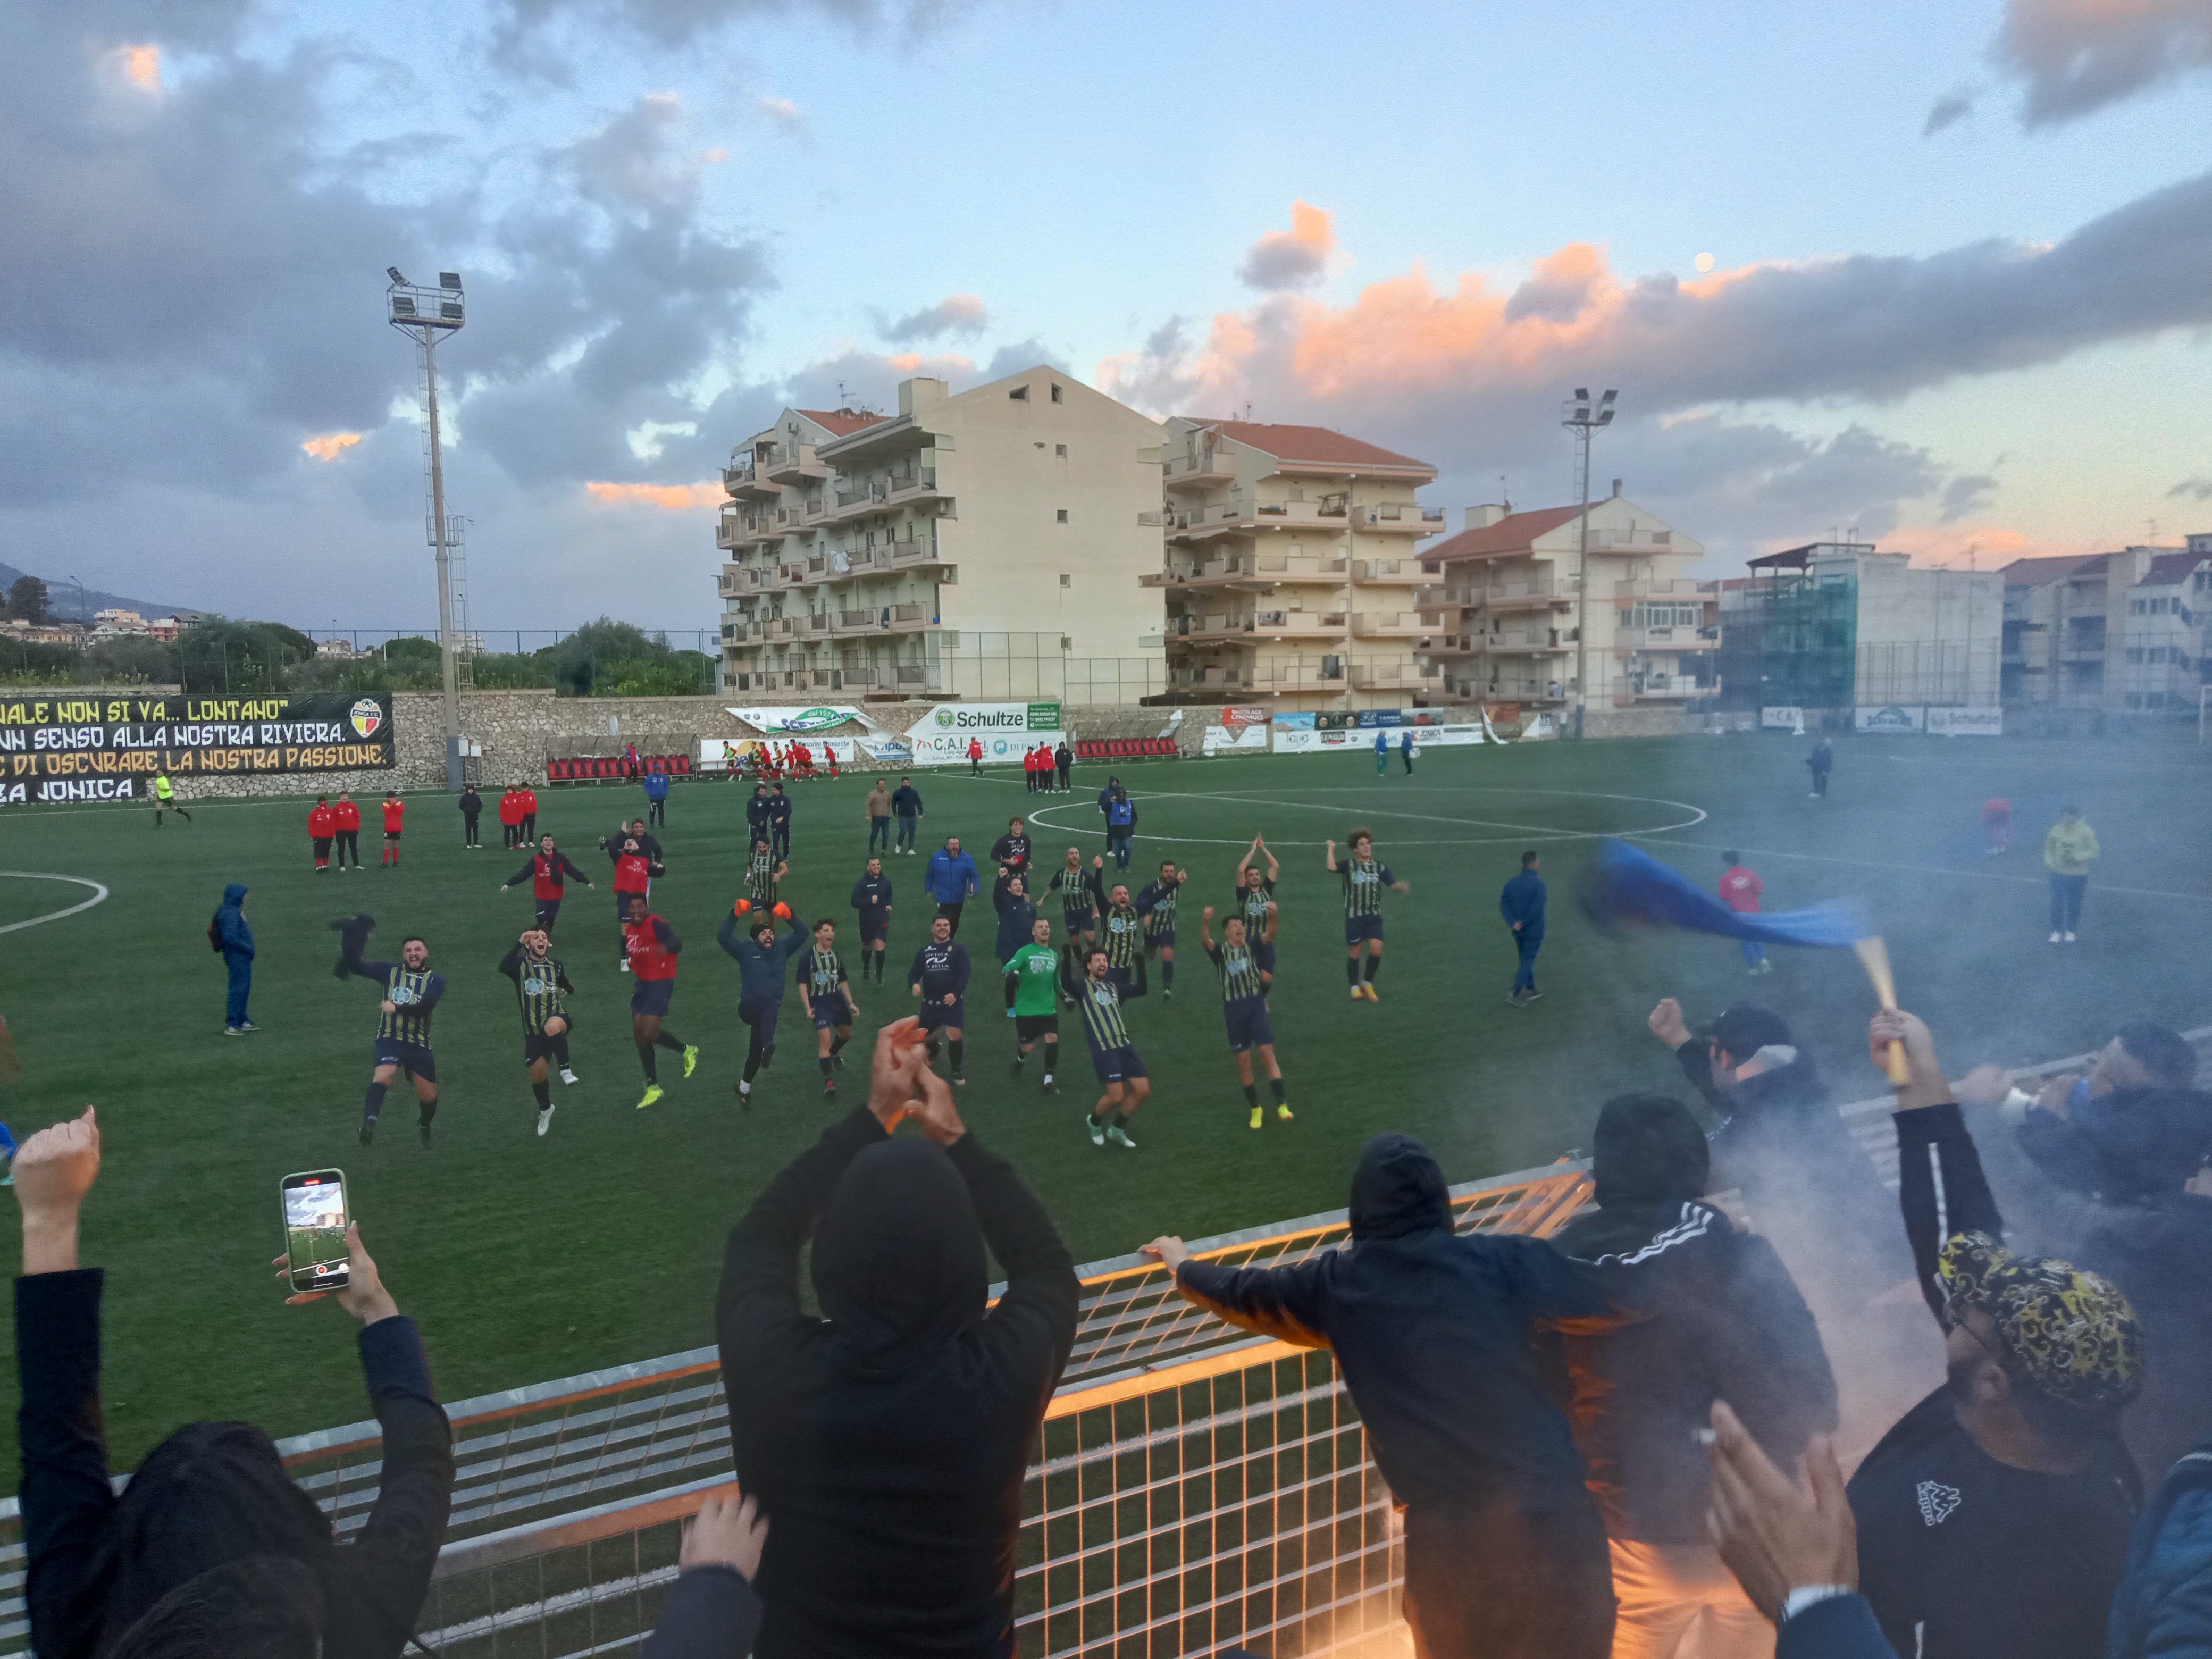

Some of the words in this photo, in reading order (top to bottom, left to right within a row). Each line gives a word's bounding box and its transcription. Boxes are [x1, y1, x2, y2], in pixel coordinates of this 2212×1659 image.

[57, 701, 100, 723] NON
[108, 701, 130, 722] SI
[138, 701, 180, 721] VA...
[957, 711, 1023, 727] Schultze
[34, 727, 104, 749] SENSO
[113, 726, 166, 747] ALLA
[174, 725, 254, 746] NOSTRA
[261, 723, 346, 744] RIVIERA.
[934, 736, 966, 750] C.A.I.
[14, 755, 38, 775] DI
[166, 750, 193, 770] LA
[200, 748, 279, 770] NOSTRA
[286, 744, 386, 767] PASSIONE.
[37, 778, 133, 800] JONICA
